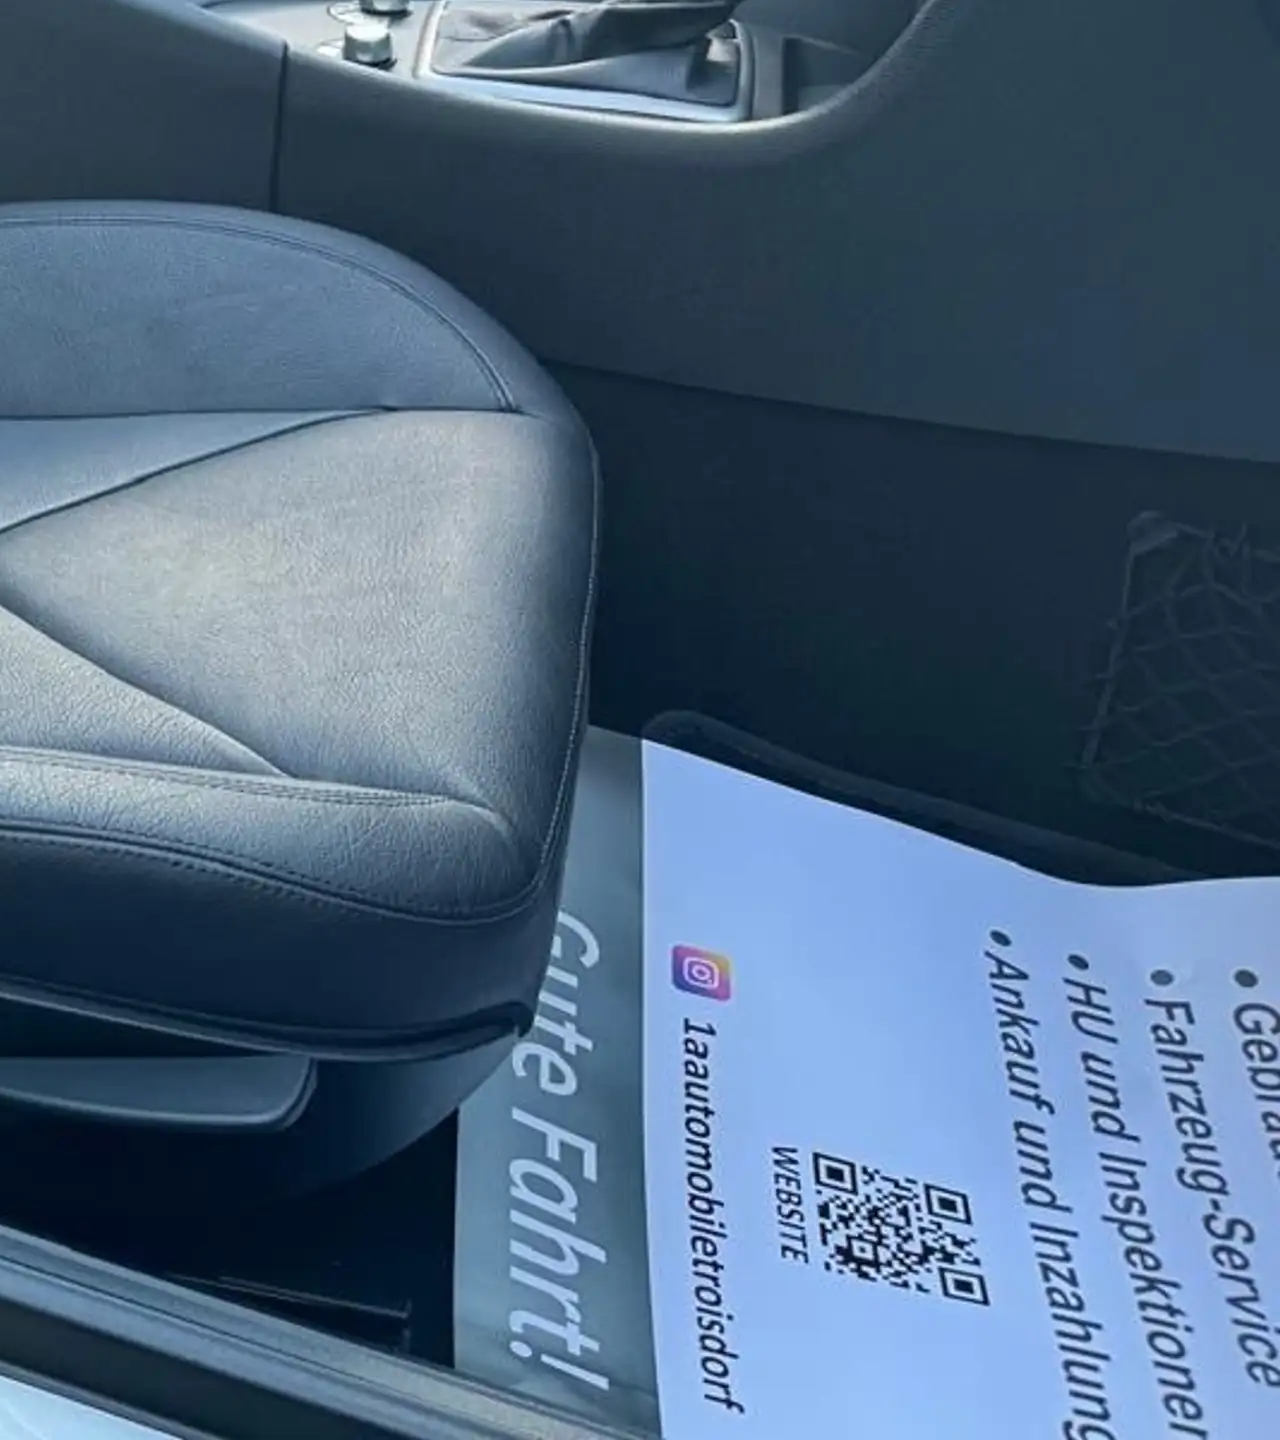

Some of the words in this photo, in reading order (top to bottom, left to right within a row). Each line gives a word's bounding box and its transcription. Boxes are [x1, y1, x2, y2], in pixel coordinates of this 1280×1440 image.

[985, 951, 1055, 1114] Ankauf
[1062, 977, 1120, 1045] HU
[1080, 1051, 1141, 1143] und
[683, 1018, 745, 1416] 1aautomobiletroisdorf
[770, 1146, 809, 1264] WEBSITE
[1013, 1120, 1073, 1215] und
[1144, 998, 1280, 1388] Fahrzeug-Service
[509, 1106, 610, 1392] Fahrt!
